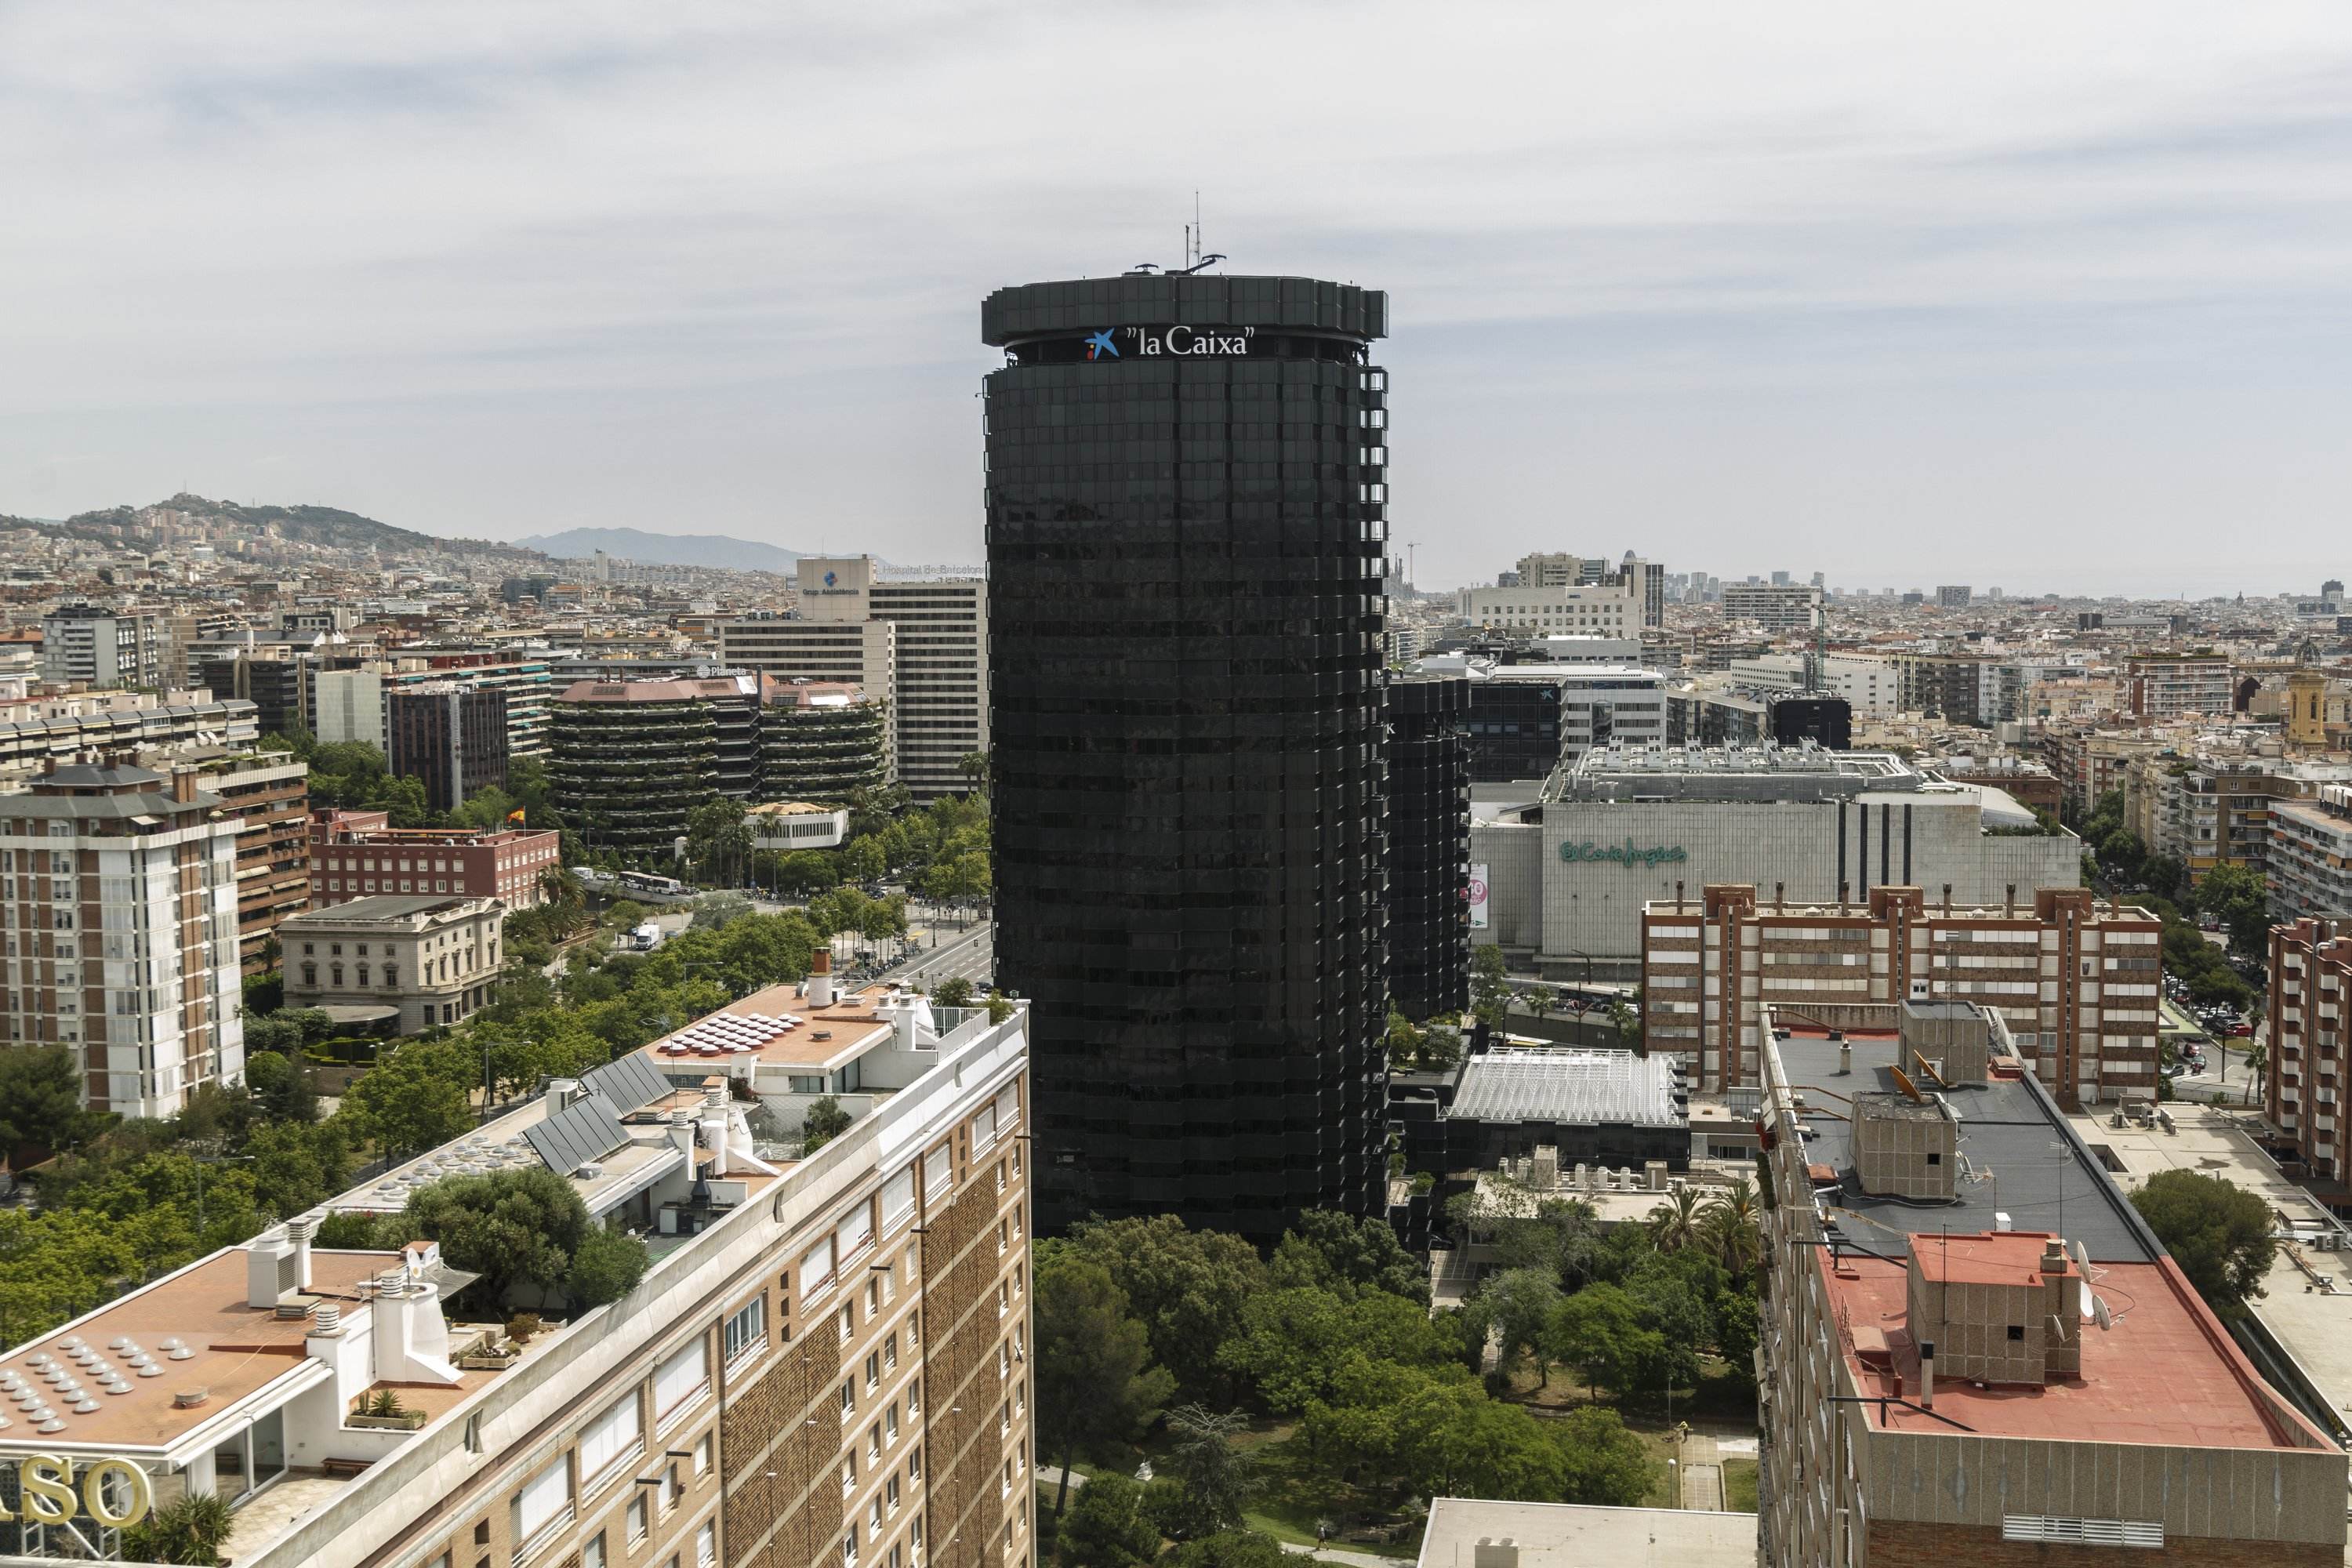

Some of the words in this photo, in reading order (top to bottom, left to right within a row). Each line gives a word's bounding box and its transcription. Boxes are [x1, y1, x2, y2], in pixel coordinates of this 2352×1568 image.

[884, 564, 922, 575] Hospital
[924, 564, 936, 574] de
[711, 666, 746, 676] Planeta
[1561, 841, 1578, 862] El
[1581, 842, 1623, 862] Corte
[1623, 837, 1688, 868] Inglés
